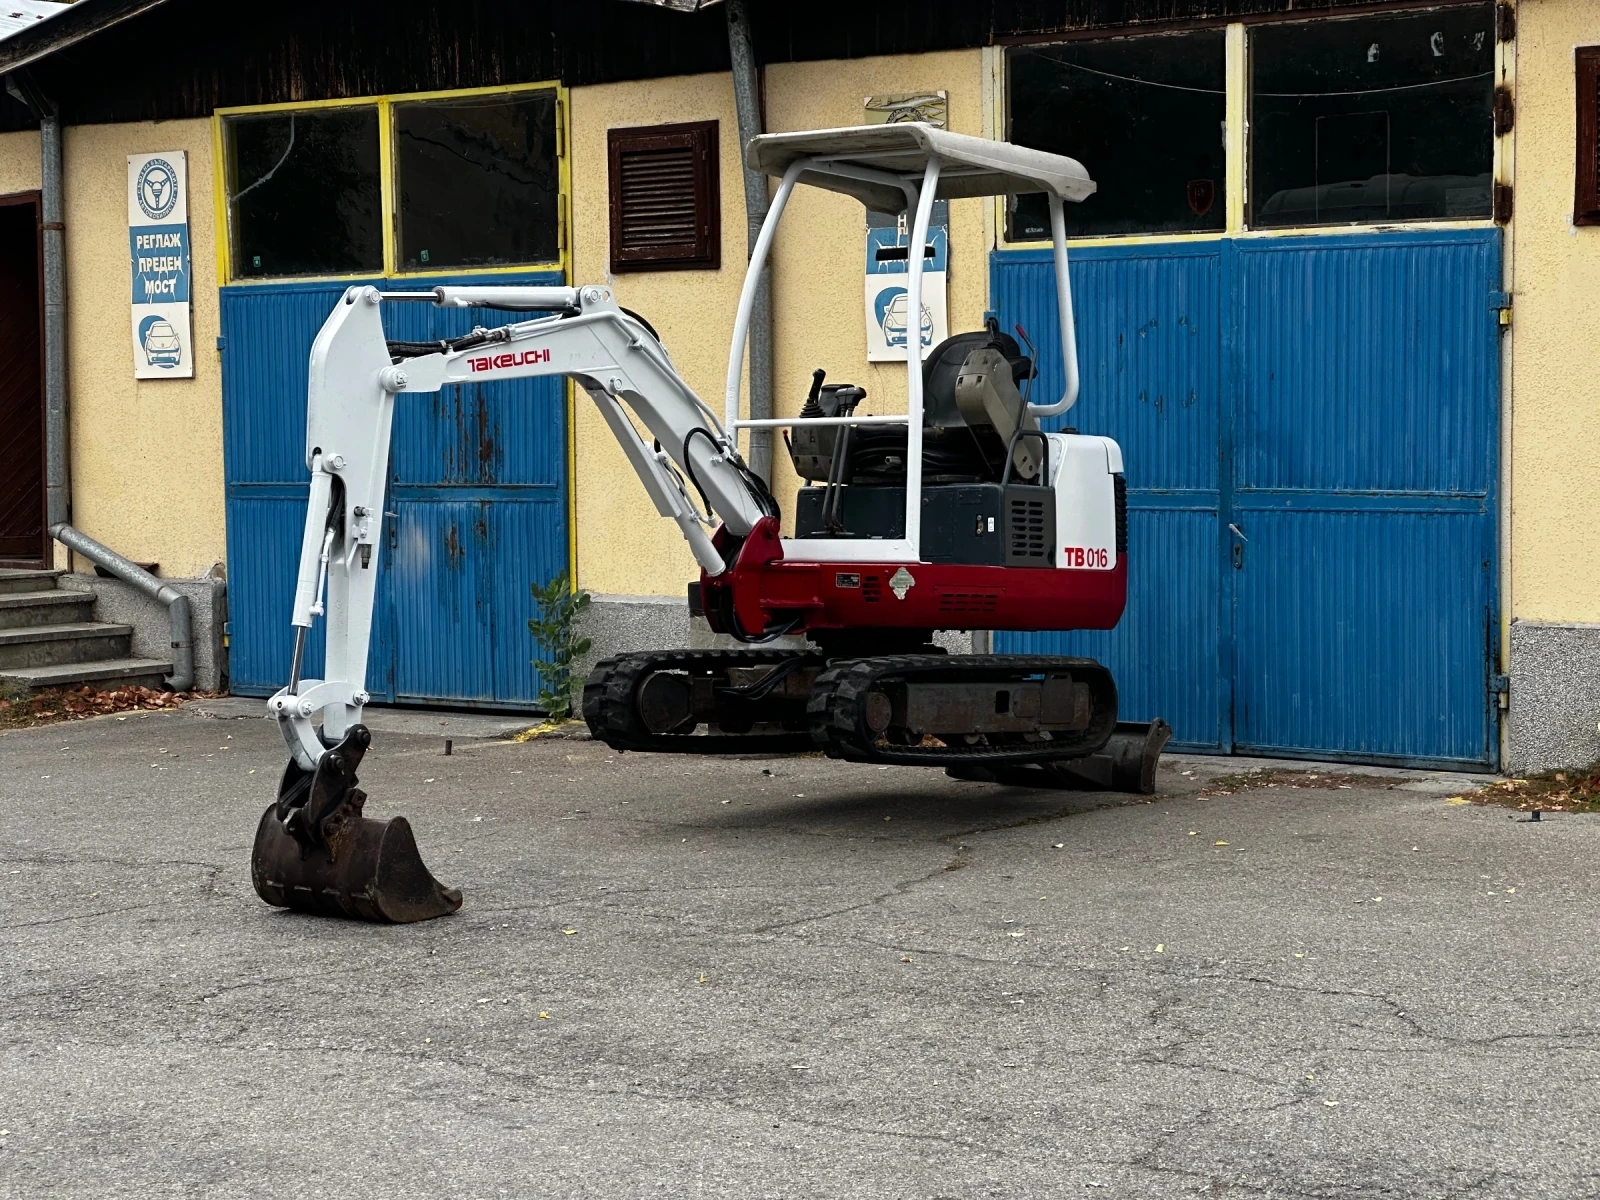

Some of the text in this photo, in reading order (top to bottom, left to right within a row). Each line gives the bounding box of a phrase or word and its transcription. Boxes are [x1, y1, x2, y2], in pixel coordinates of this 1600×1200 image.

[136, 233, 181, 249] РЕГЛАЖ
[139, 256, 182, 273] ПРЕДЕН
[145, 279, 176, 294] МОСТ
[467, 348, 550, 372] TAKEUCHI
